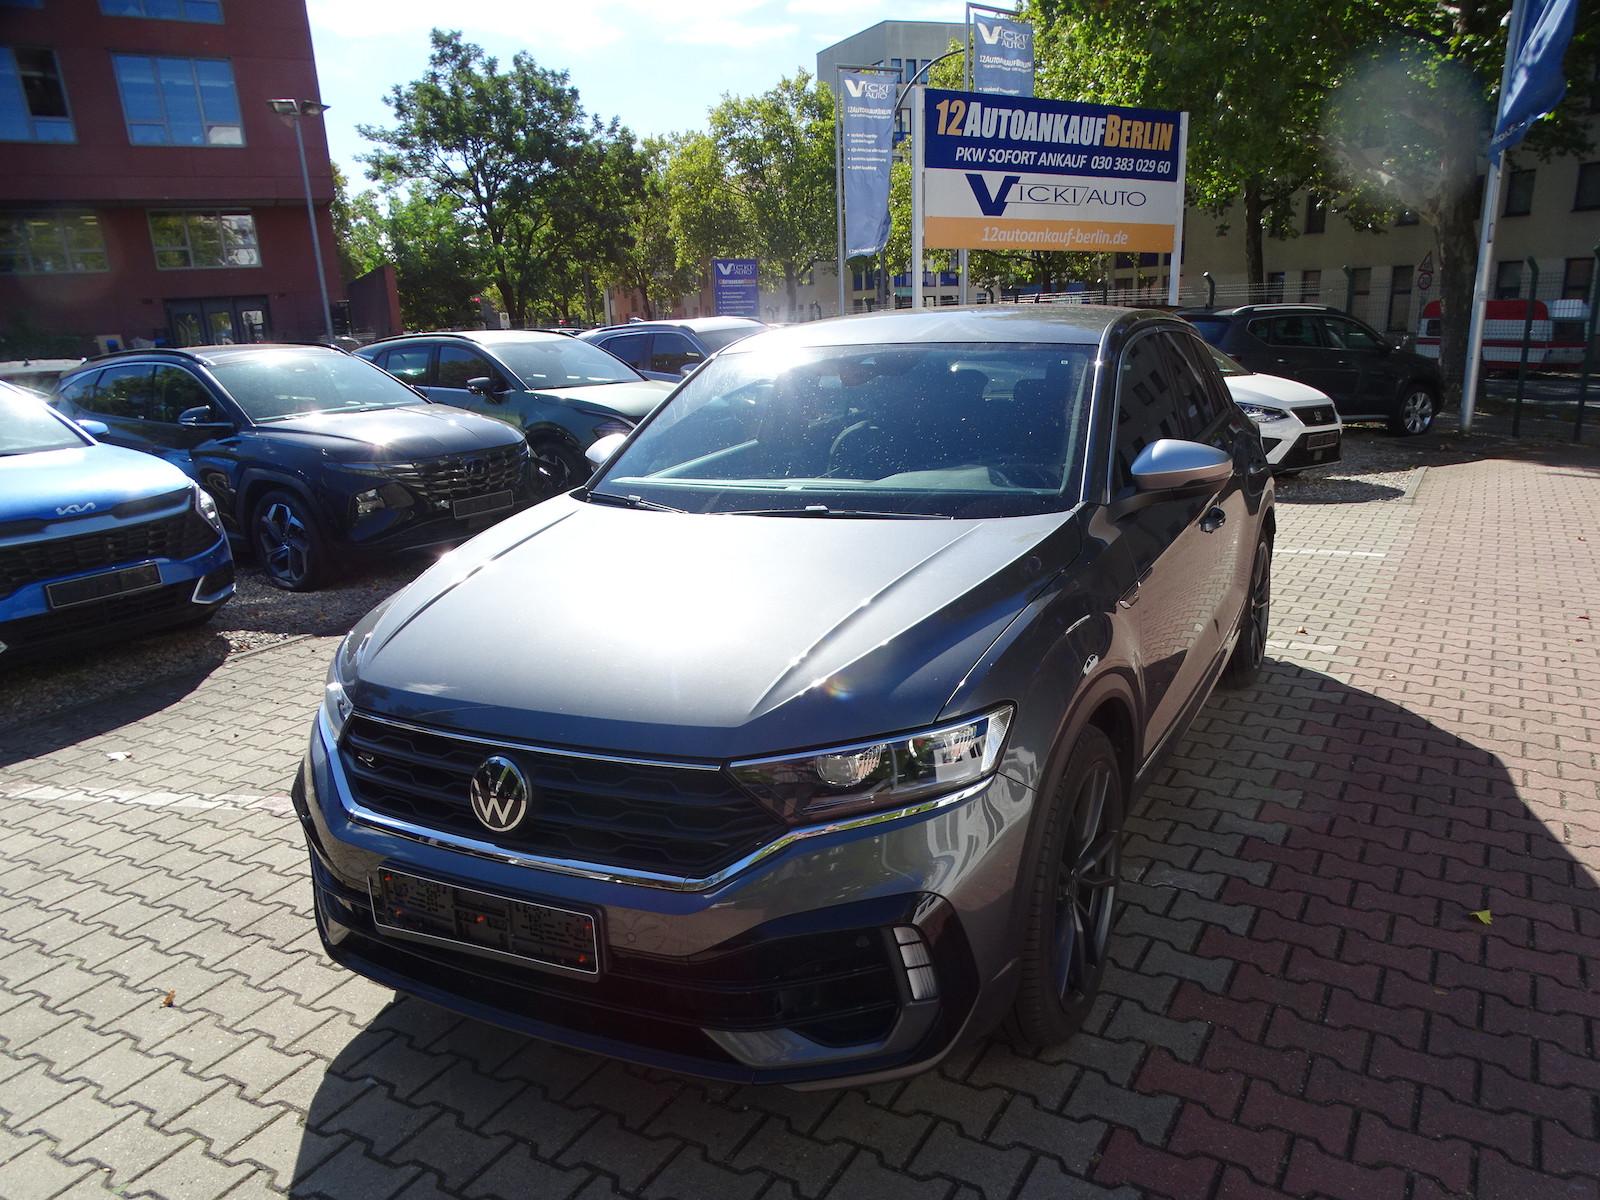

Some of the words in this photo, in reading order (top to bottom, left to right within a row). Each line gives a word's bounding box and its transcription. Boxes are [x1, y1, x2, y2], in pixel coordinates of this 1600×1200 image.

[955, 147, 986, 162] PKW
[989, 149, 1035, 165] SOFORT
[1038, 151, 1087, 168] ANKAUF
[1090, 155, 1111, 170] 030
[1113, 157, 1134, 172] 383
[1135, 158, 1157, 173] 029
[1157, 160, 1171, 174] 60
[981, 226, 1129, 246] 12autoankauf-berlin.de
